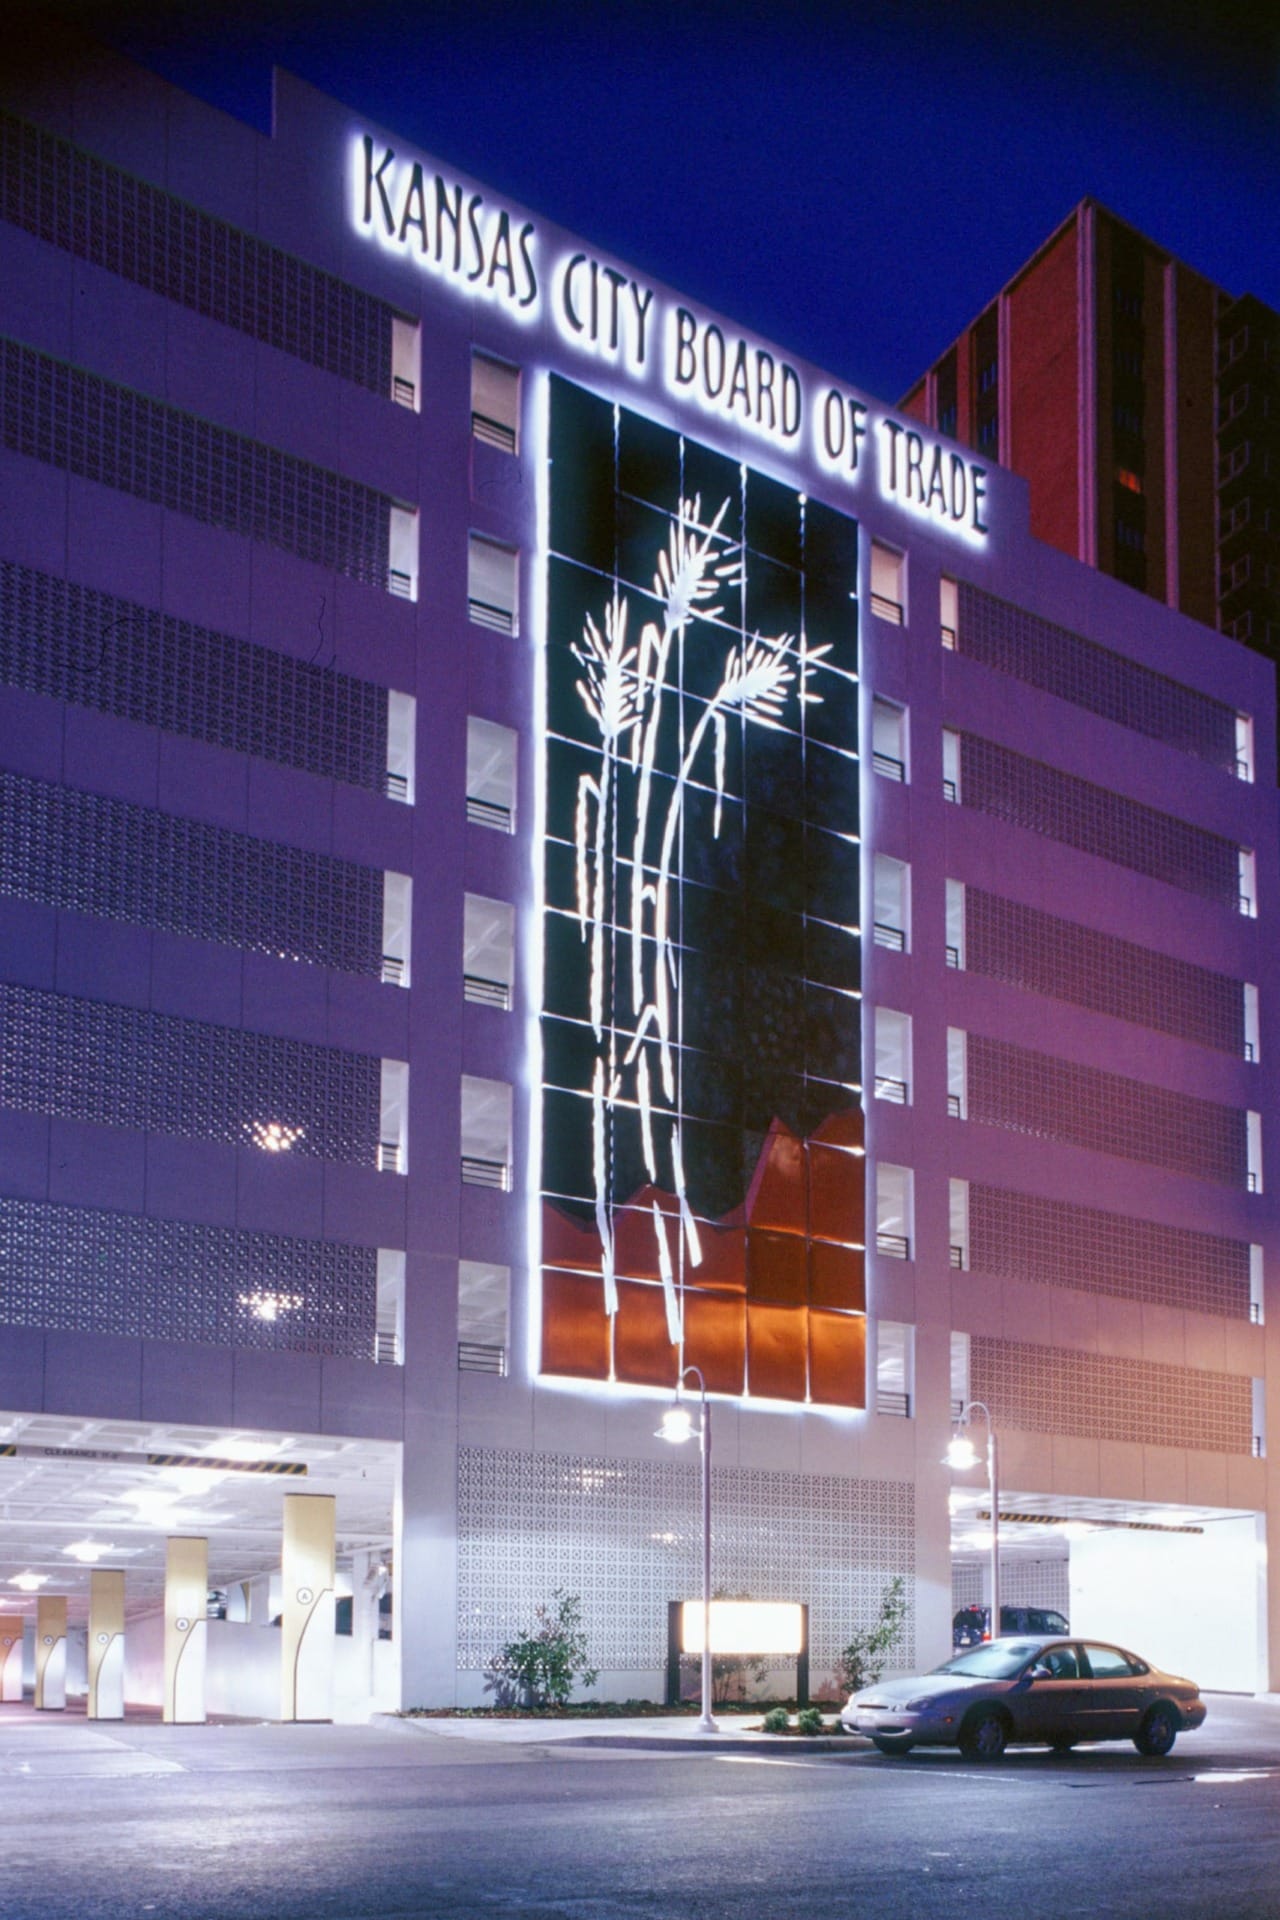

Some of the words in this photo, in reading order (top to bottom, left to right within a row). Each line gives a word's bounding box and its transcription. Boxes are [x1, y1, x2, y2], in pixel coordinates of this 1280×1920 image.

[363, 135, 537, 307] KANSAS
[564, 254, 654, 364] CITY
[675, 307, 802, 438] BOARD
[824, 389, 868, 471] OF
[882, 419, 988, 535] TRADE
[44, 1447, 97, 1459] CLEARANCE
